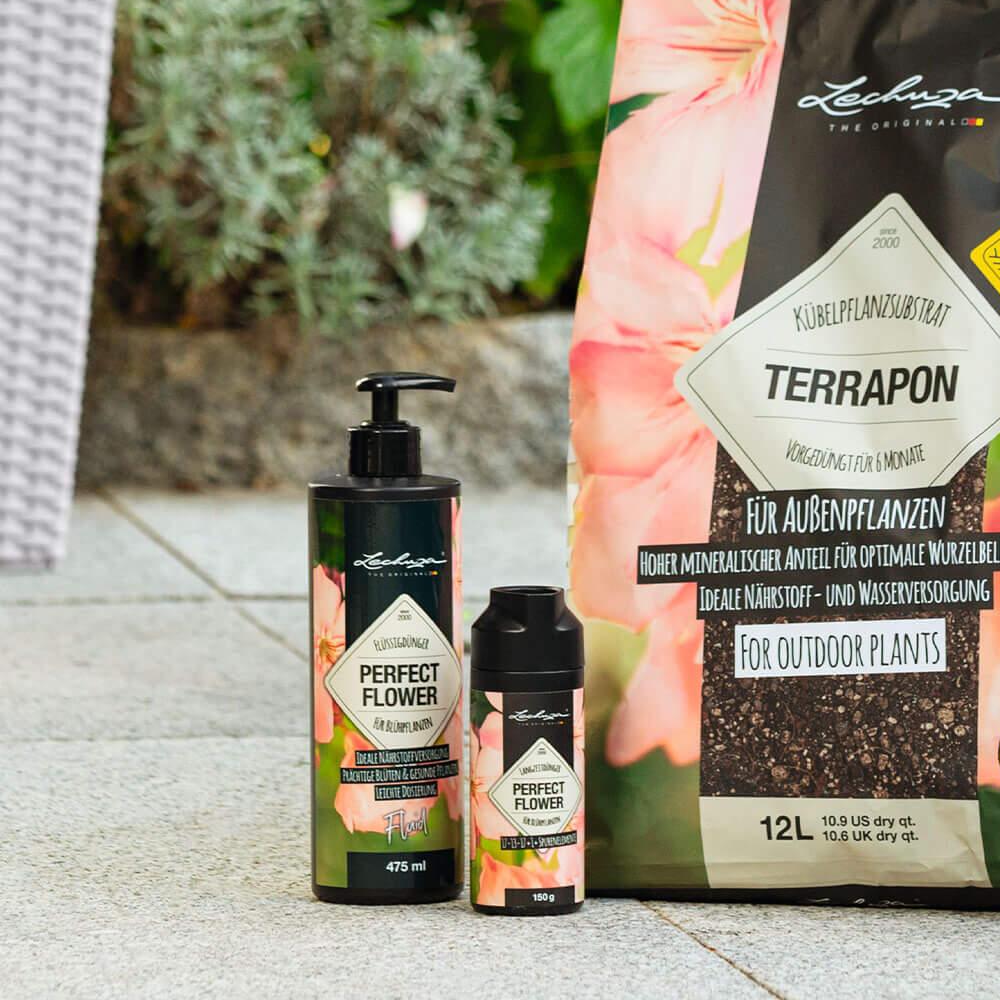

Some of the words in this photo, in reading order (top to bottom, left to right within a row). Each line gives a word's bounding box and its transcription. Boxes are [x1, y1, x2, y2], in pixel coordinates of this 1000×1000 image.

[829, 123, 861, 132] THE
[872, 118, 957, 131] ORIGINAL
[872, 236, 901, 250] 2000
[792, 293, 952, 333] KÜBELPFLANZSUBSTRAT
[763, 362, 960, 408] TERRAPON
[785, 438, 853, 472] VORGEDÜNGT
[853, 451, 873, 473] FÜR
[876, 452, 883, 473] 6
[884, 443, 926, 472] MONATE
[746, 496, 779, 536] FÜR
[639, 551, 679, 577] HOHER
[680, 547, 782, 576] MINERALISCHER
[784, 544, 832, 571] ANTEIL
[833, 543, 857, 569] FÜR
[859, 542, 926, 569] OPTIMALE
[699, 585, 742, 611] IDEALE
[825, 583, 856, 607] UND
[858, 577, 992, 606] WASSERVERSORGUNG
[740, 632, 770, 671] FOR
[777, 634, 864, 671] OUTDOOR
[869, 631, 942, 667] PLANTS
[359, 662, 440, 685] PERFECT
[362, 685, 438, 707] FLOWER
[512, 781, 566, 797] PERFECT
[514, 796, 565, 811] FLOWER
[383, 807, 429, 845] Fluid
[759, 814, 815, 841] 12L
[821, 815, 848, 827] 10.9
[851, 815, 871, 827] US
[873, 815, 897, 830] dry
[898, 816, 917, 830] qt.
[822, 830, 849, 842] 10.6
[852, 830, 873, 842] UK
[875, 830, 899, 844] dry
[901, 830, 919, 844] qt.
[385, 861, 409, 873] 475
[411, 860, 427, 872] ml
